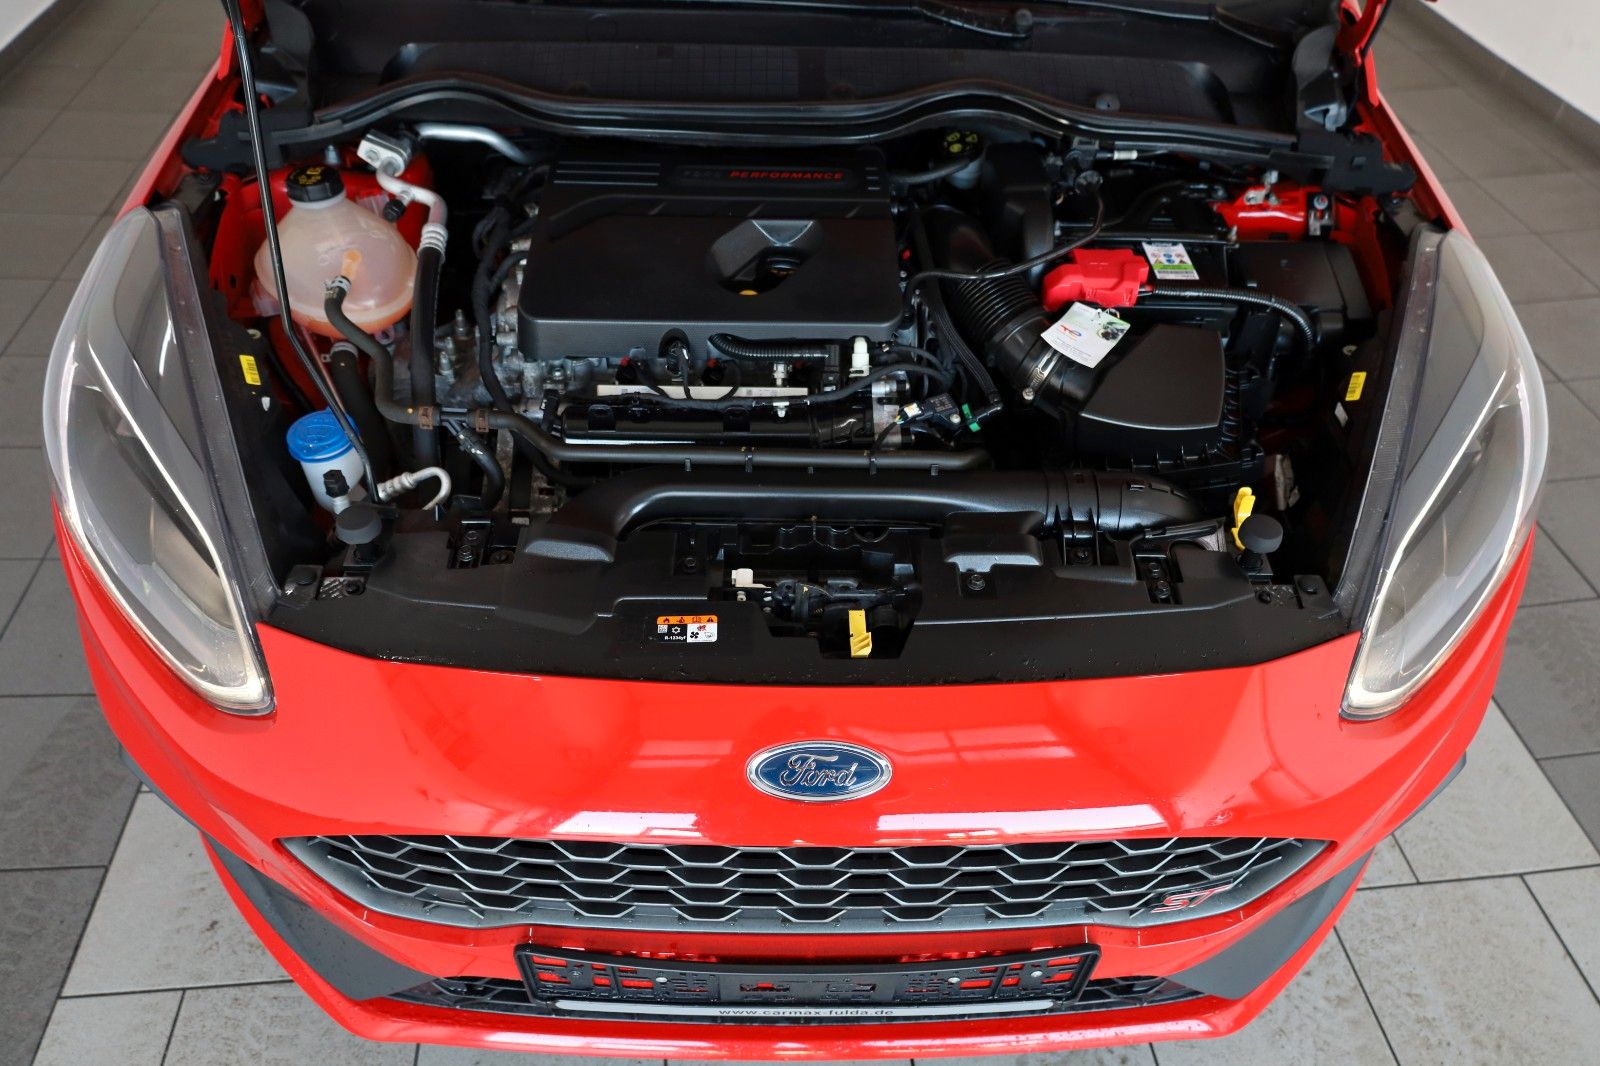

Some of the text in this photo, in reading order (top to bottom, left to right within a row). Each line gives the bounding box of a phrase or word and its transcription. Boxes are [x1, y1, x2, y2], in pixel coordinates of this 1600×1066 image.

[729, 169, 844, 180] PERFORMANCE
[780, 753, 858, 787] Ford
[1150, 884, 1233, 913] ST
